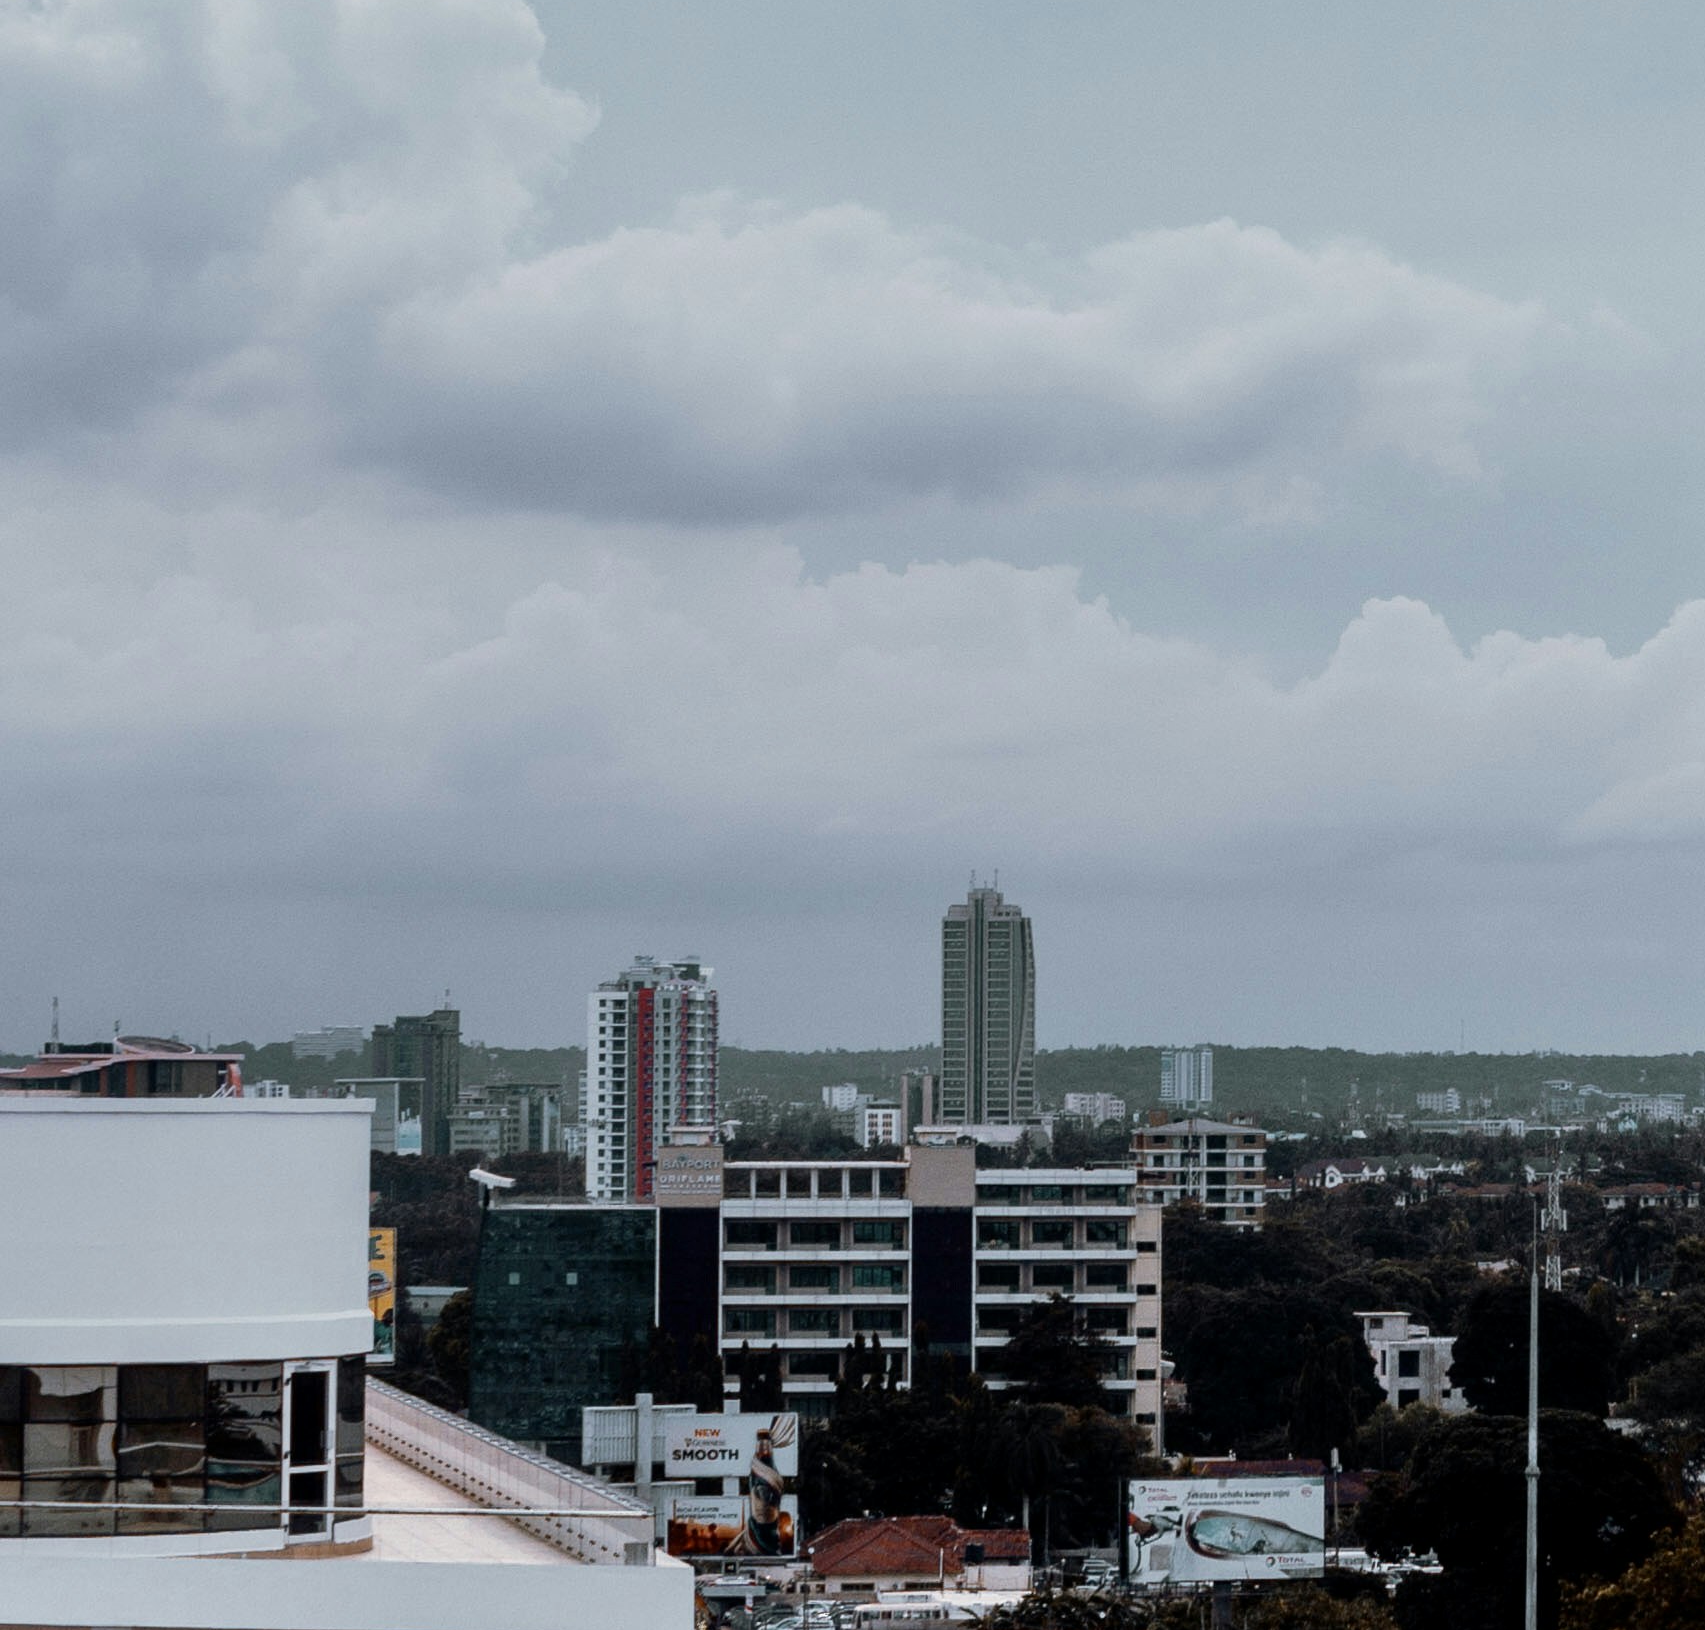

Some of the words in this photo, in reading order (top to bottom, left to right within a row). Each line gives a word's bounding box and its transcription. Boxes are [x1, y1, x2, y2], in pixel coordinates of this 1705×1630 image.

[663, 1159, 720, 1170] BAYPORT
[660, 1174, 721, 1184] ORIFLAME
[694, 1428, 720, 1437] NEW
[672, 1449, 739, 1462] SMOOTH
